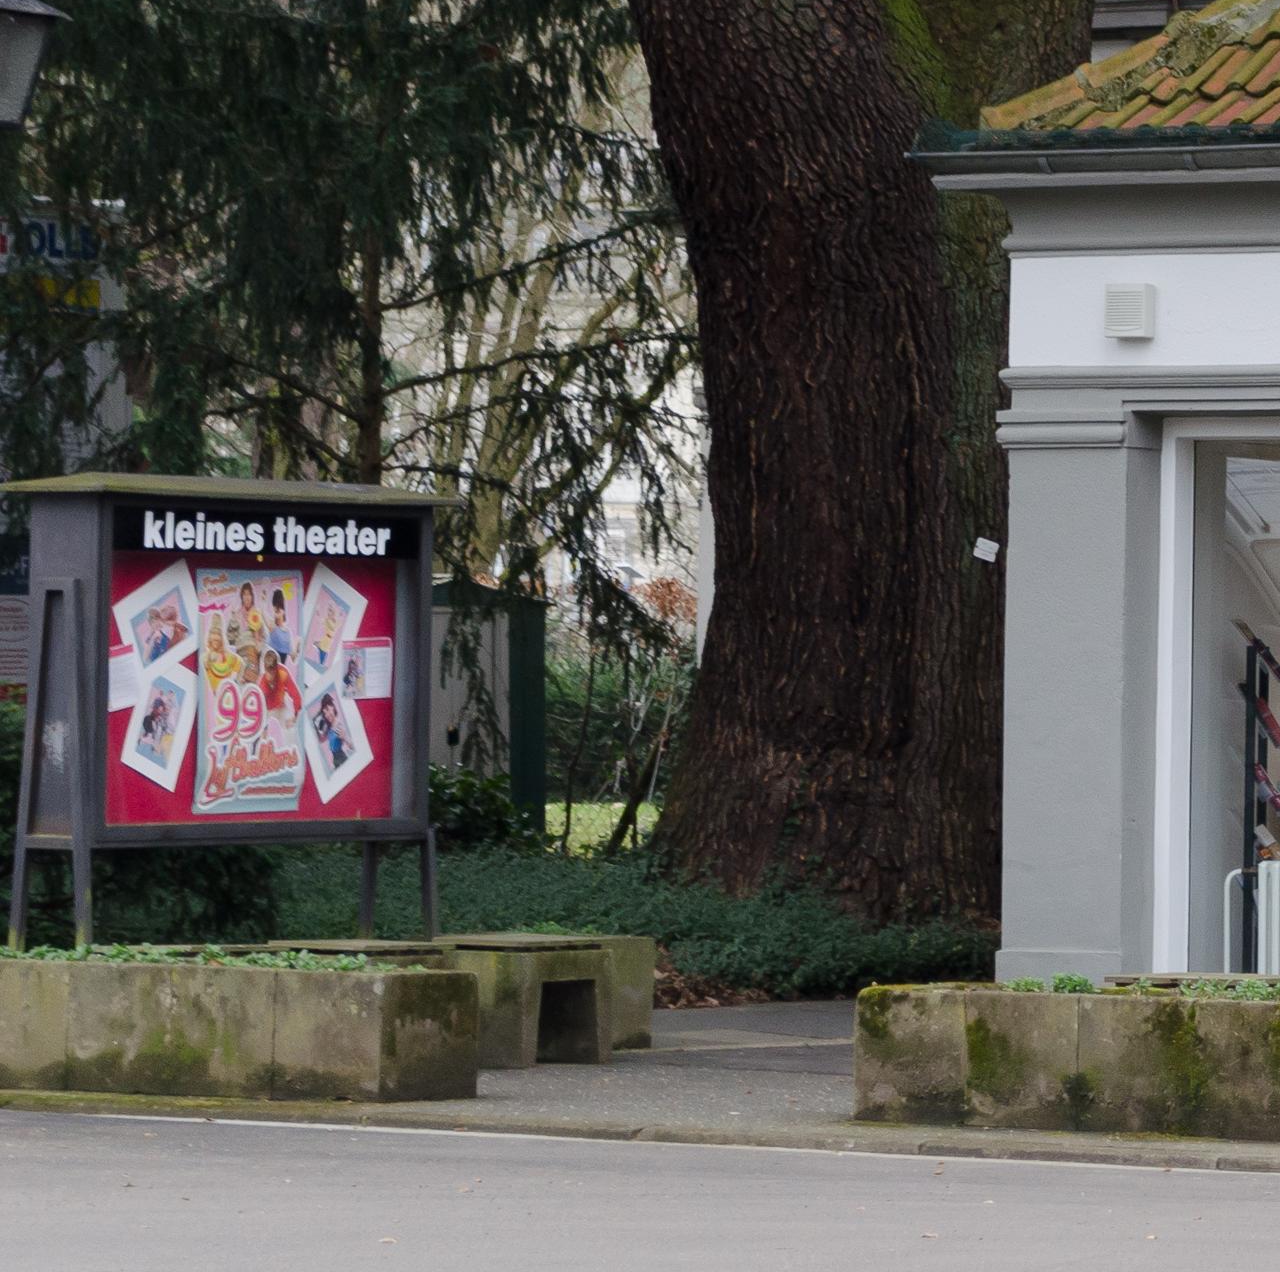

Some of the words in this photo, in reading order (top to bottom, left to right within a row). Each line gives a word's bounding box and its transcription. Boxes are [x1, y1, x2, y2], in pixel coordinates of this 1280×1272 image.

[143, 510, 265, 552] kleines
[273, 516, 392, 556] theater
[212, 682, 263, 742] 99
